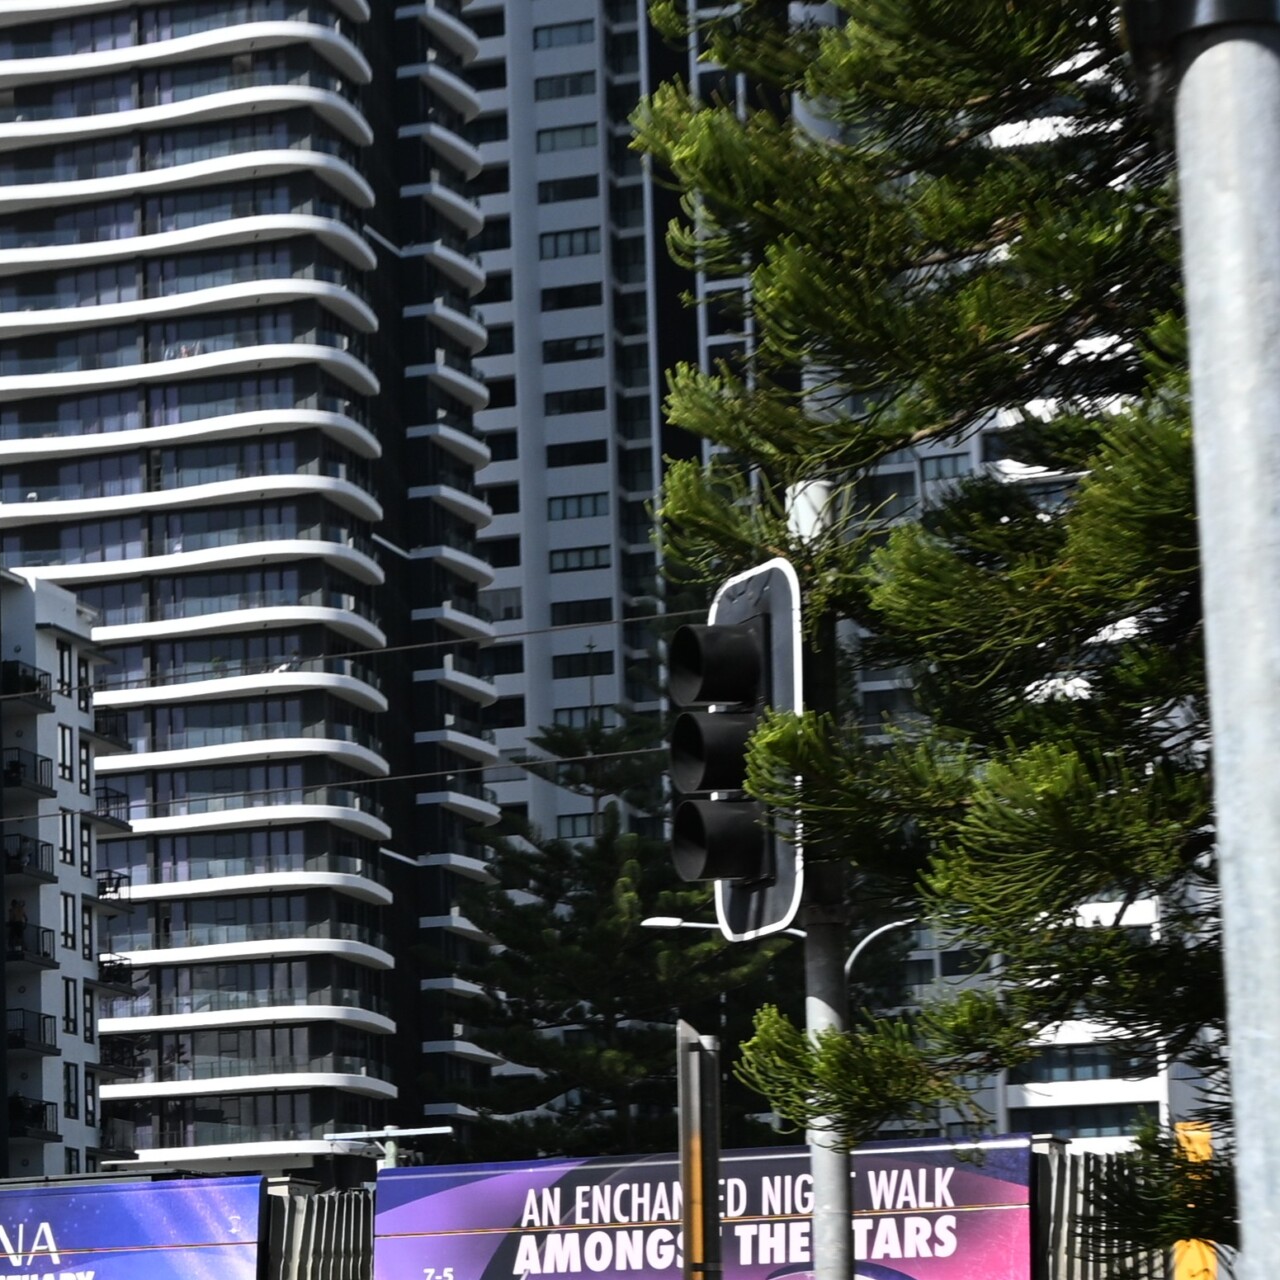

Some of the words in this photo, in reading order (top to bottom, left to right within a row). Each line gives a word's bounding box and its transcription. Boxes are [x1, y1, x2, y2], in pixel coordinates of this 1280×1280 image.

[521, 1187, 561, 1227] AN
[575, 1178, 747, 1225] ENCHAND
[762, 1170, 856, 1216] NIG
[868, 1167, 955, 1210] WALK
[513, 1226, 722, 1275] AMONG
[734, 1222, 810, 1265] THE
[852, 1215, 957, 1259] TARS
